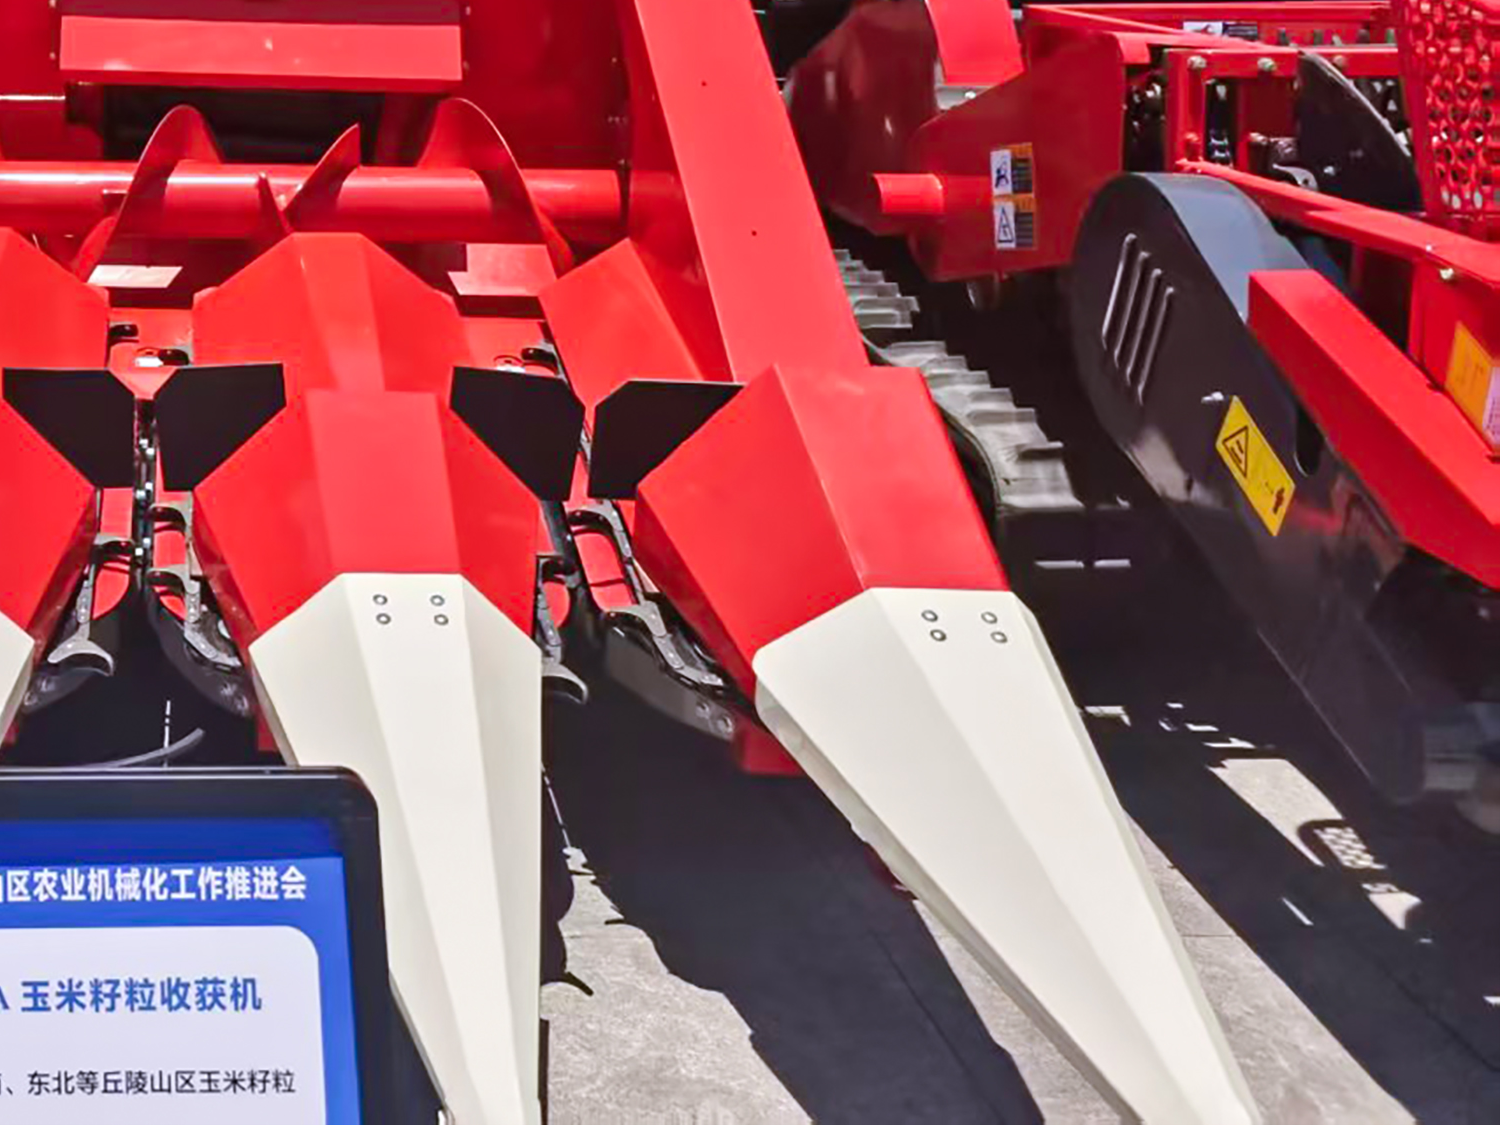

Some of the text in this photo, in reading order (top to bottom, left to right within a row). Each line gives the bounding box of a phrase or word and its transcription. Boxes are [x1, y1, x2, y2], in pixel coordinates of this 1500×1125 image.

[20, 977, 263, 1013] 玉米籽粒收获机
